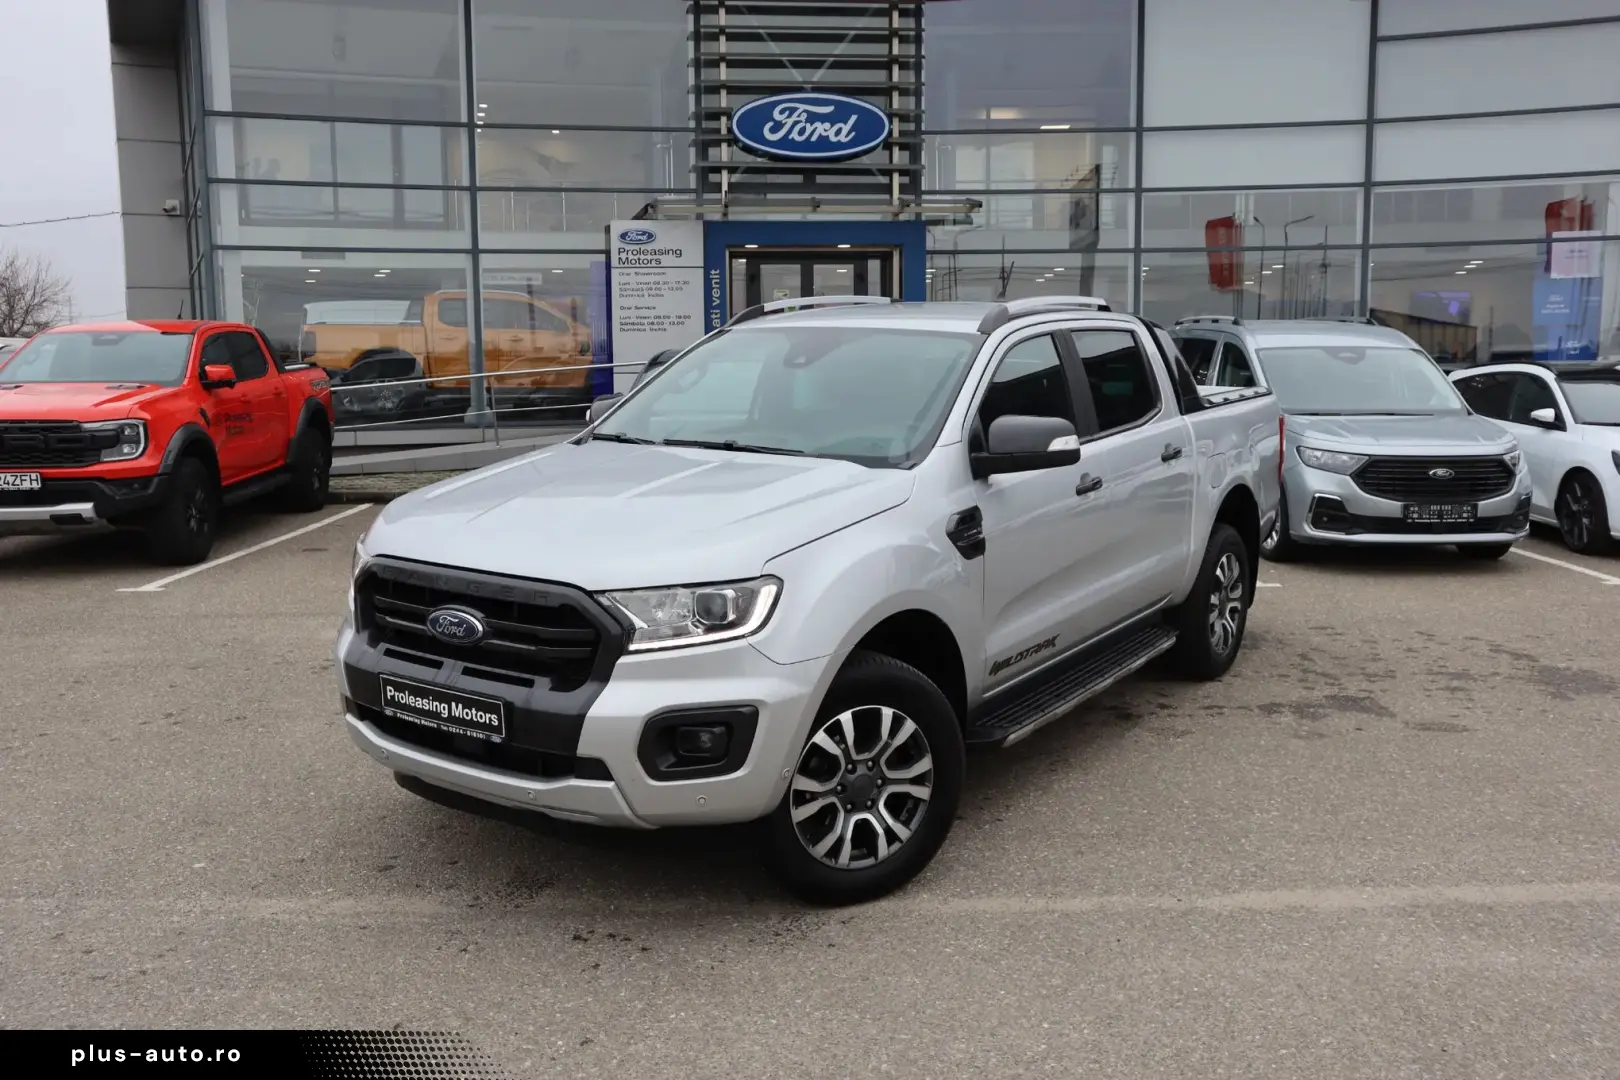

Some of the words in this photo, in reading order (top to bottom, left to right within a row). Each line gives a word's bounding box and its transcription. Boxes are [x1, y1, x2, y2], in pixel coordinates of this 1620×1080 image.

[763, 102, 858, 142] Ford
[625, 230, 649, 241] Ford
[618, 247, 683, 258] Proleasing
[618, 257, 662, 265] Motors
[710, 269, 720, 306] venit
[436, 615, 466, 637] Ford
[386, 686, 448, 718] Proleasing
[451, 701, 499, 726] Motors
